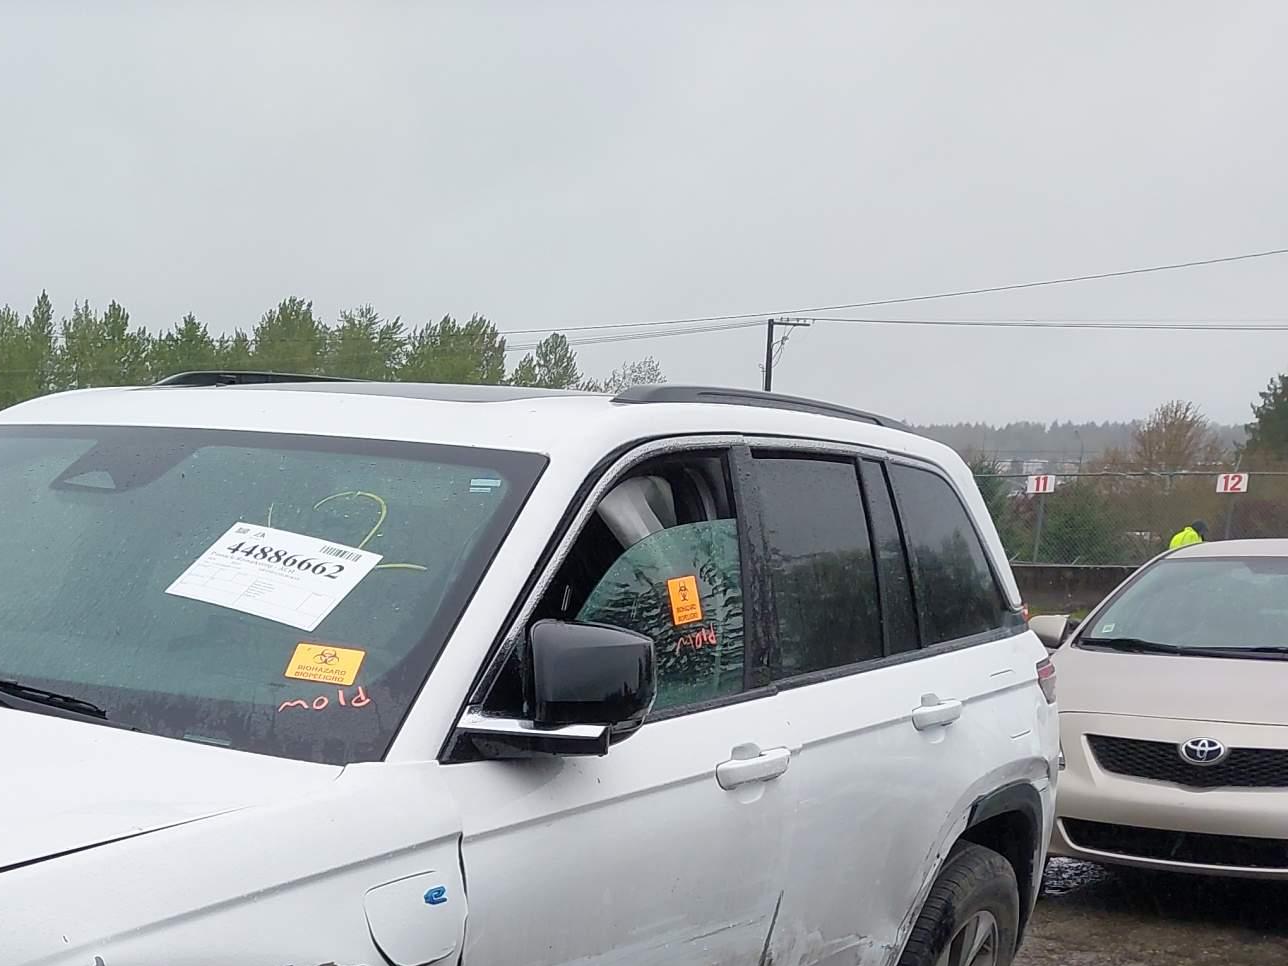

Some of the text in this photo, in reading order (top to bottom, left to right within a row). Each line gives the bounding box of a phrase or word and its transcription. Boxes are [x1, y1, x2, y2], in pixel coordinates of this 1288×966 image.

[1035, 476, 1048, 492] 11
[1223, 474, 1243, 491] 12
[227, 541, 346, 580] 44886662
[297, 664, 347, 676] BIOHAZARD
[278, 685, 372, 713] mold
